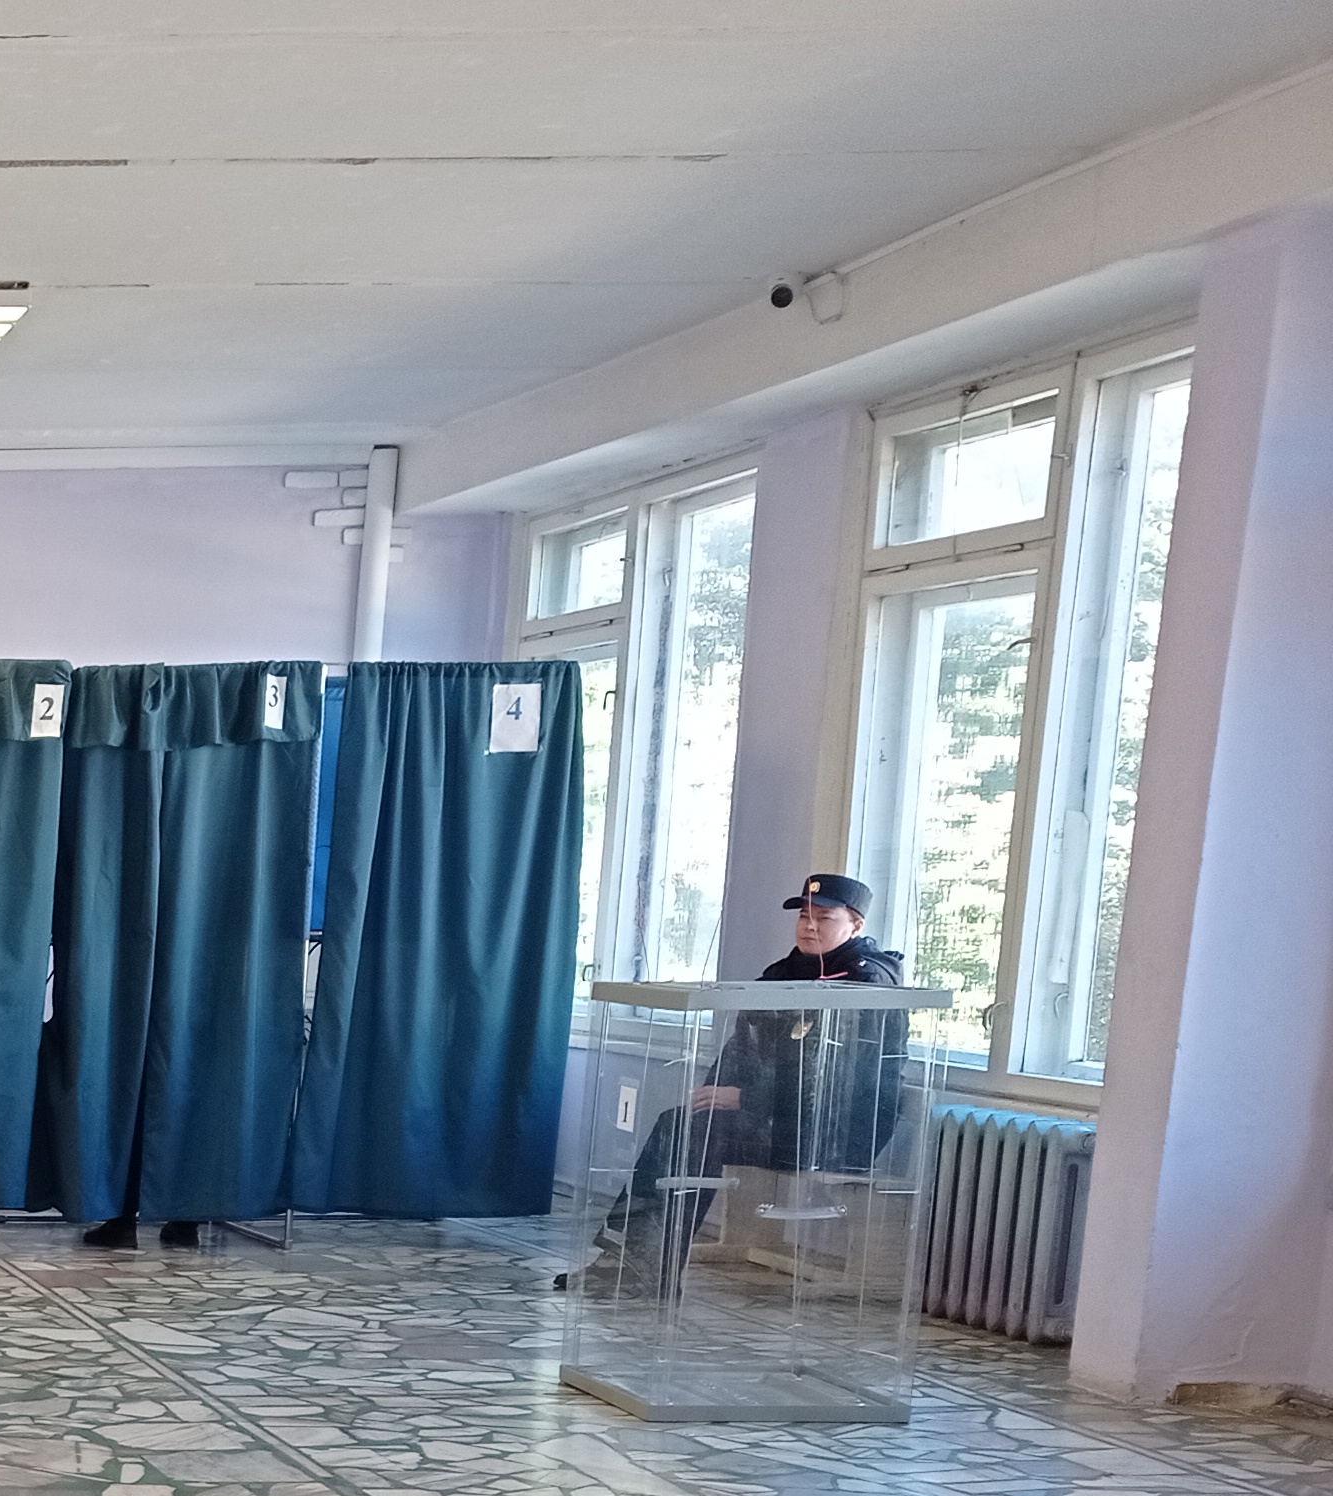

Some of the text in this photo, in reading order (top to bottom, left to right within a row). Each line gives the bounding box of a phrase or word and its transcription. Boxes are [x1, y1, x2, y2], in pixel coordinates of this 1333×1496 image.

[39, 696, 55, 721] 2
[268, 685, 279, 708] 3
[505, 696, 523, 721] 4
[622, 1101, 629, 1123] 1
